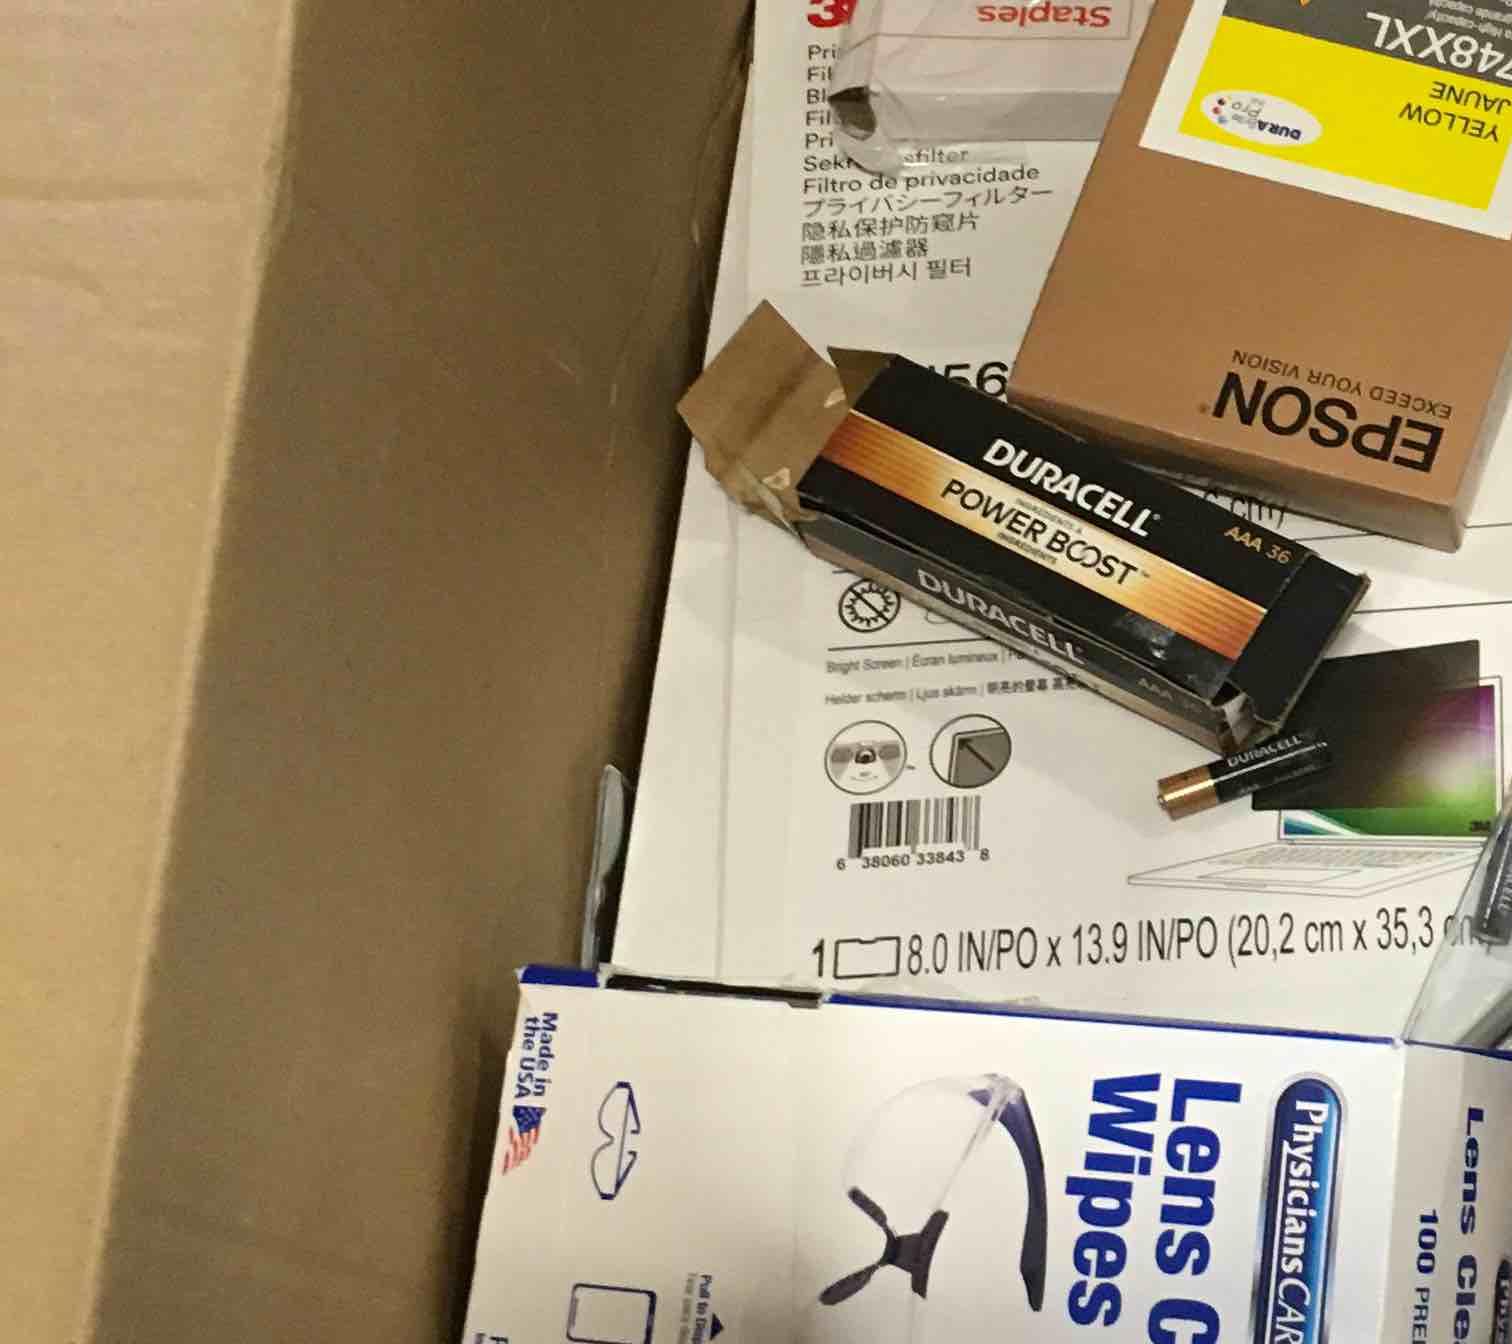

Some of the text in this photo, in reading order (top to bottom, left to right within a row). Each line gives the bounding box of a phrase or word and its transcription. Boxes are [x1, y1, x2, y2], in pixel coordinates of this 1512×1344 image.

[977, 0, 1114, 28] Staples
[1399, 102, 1500, 143] YELLOW
[1430, 80, 1512, 115] JAUNE
[803, 164, 1041, 194] Filtro de privacidade
[926, 257, 973, 280] 필터
[1232, 348, 1452, 420] EXCEED YOUR VISION
[1213, 372, 1445, 474] EPSON
[983, 438, 1153, 538] DURACELL
[940, 477, 1139, 586] POWER BOOST
[1224, 525, 1292, 565] AAA 36
[916, 568, 1085, 666] DURACELL
[836, 848, 990, 871] 6 38060 33843 8
[812, 938, 825, 978] 1
[907, 932, 948, 976] 8.0
[957, 926, 1038, 973] IN/PO
[1046, 936, 1062, 968] x
[1072, 921, 1128, 966] 13.9
[1137, 915, 1218, 962] IN/PO
[1228, 911, 1295, 969] (20,2
[1304, 920, 1343, 954] cm
[1352, 919, 1368, 952] x
[1376, 906, 1434, 956] 35,3
[514, 1016, 540, 1098] the USA
[533, 1012, 559, 1096] Made in
[1064, 1072, 1163, 1328] Wipes
[1156, 1075, 1243, 1277] Lens
[1460, 1107, 1485, 1235] Lens
[1416, 1208, 1439, 1274] 100
